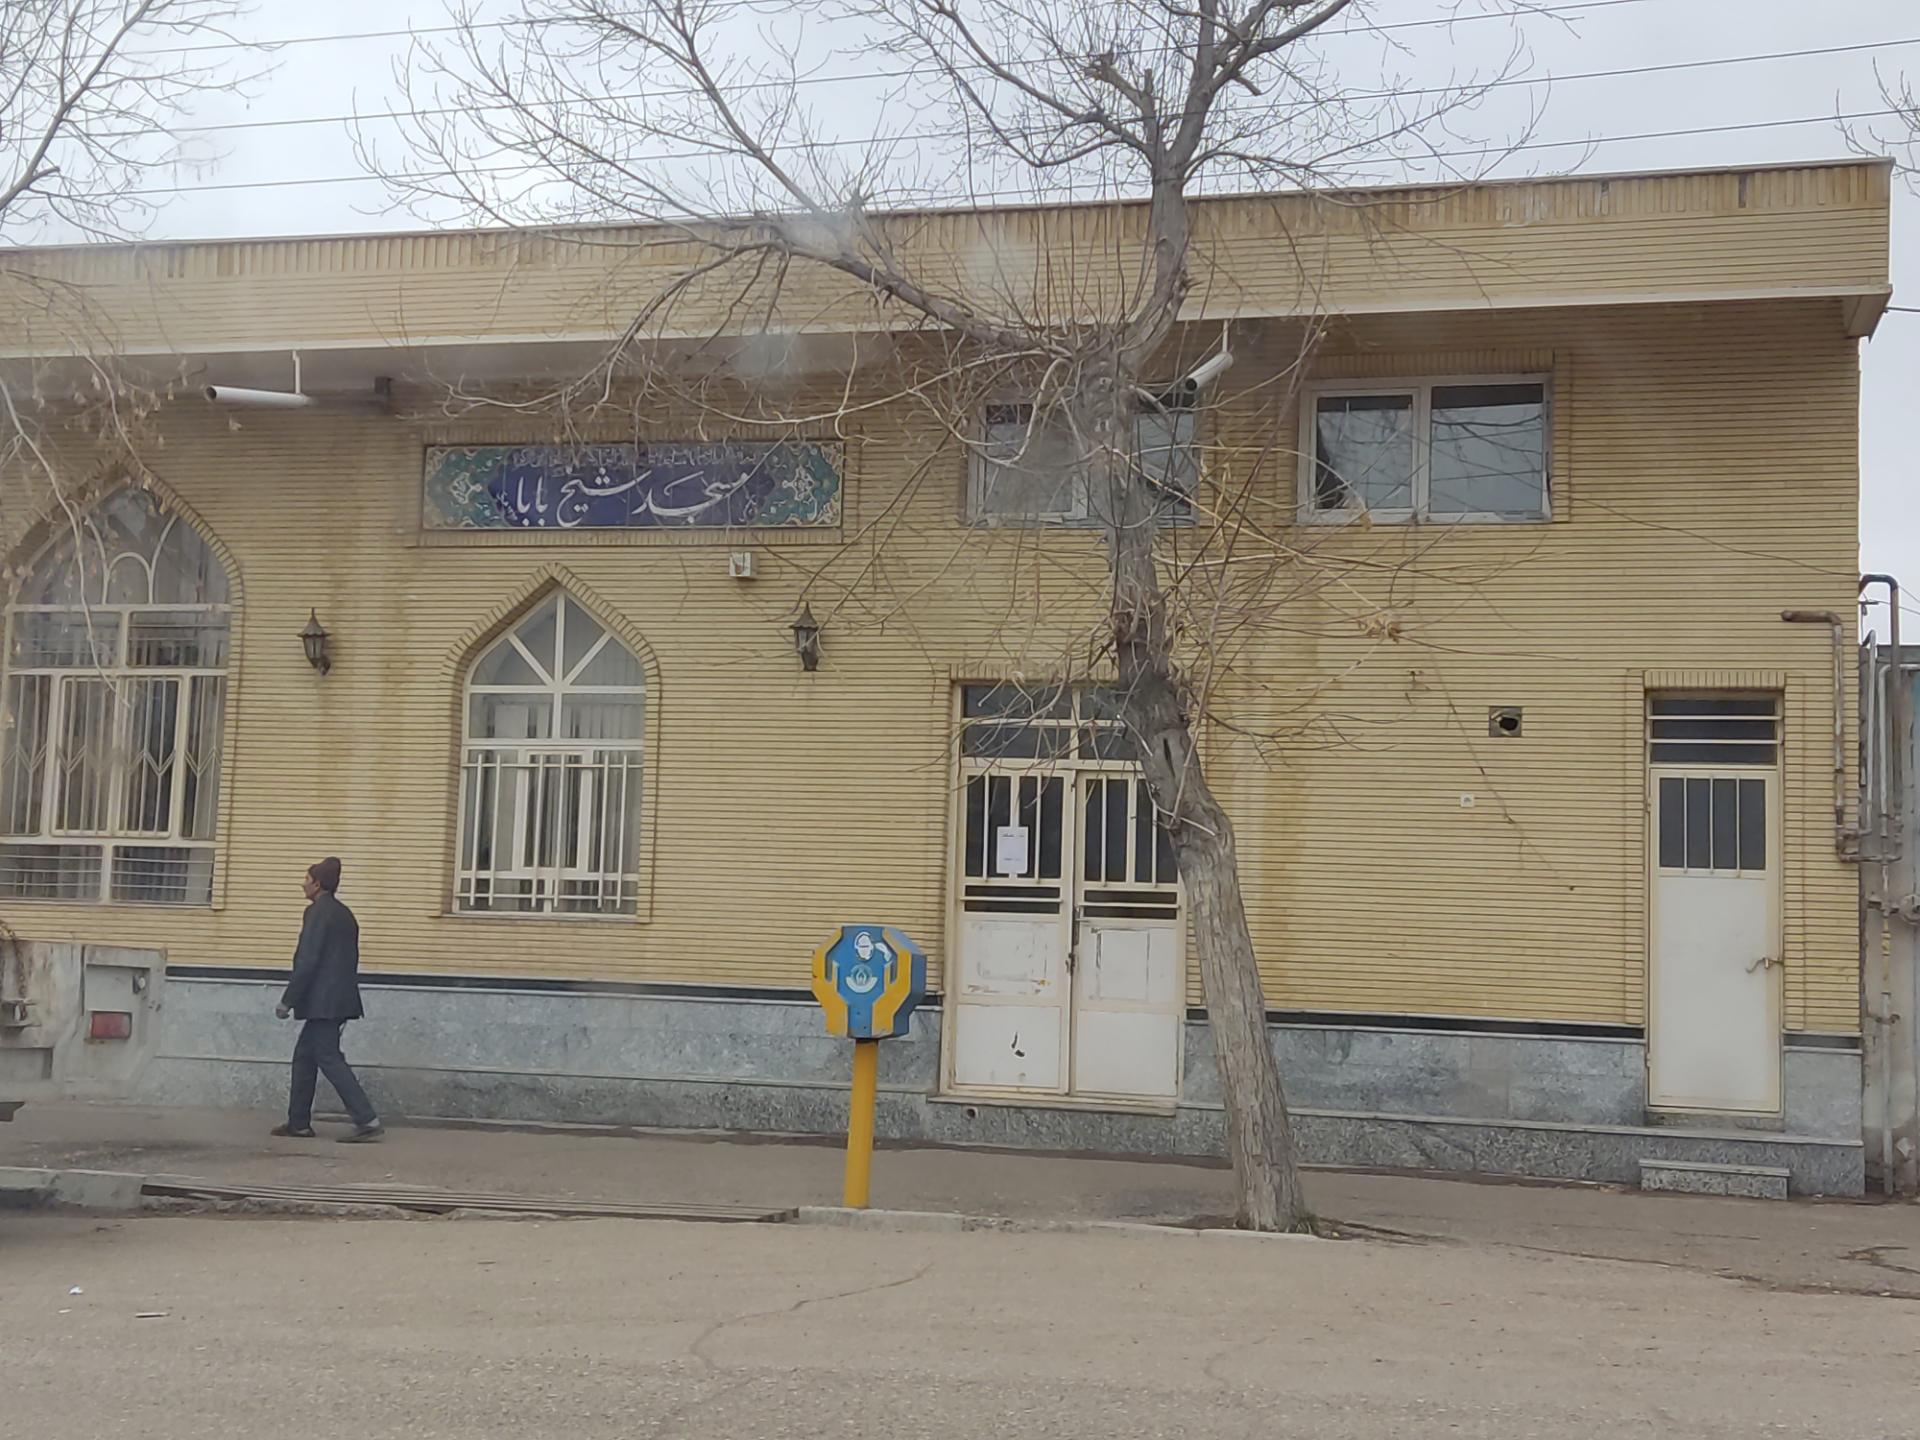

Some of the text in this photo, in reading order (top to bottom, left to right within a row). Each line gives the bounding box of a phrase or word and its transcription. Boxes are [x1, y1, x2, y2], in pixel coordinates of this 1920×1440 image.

[516, 475, 549, 527] بابا
[556, 466, 652, 528] شیخ
[631, 470, 748, 524] مسجد
